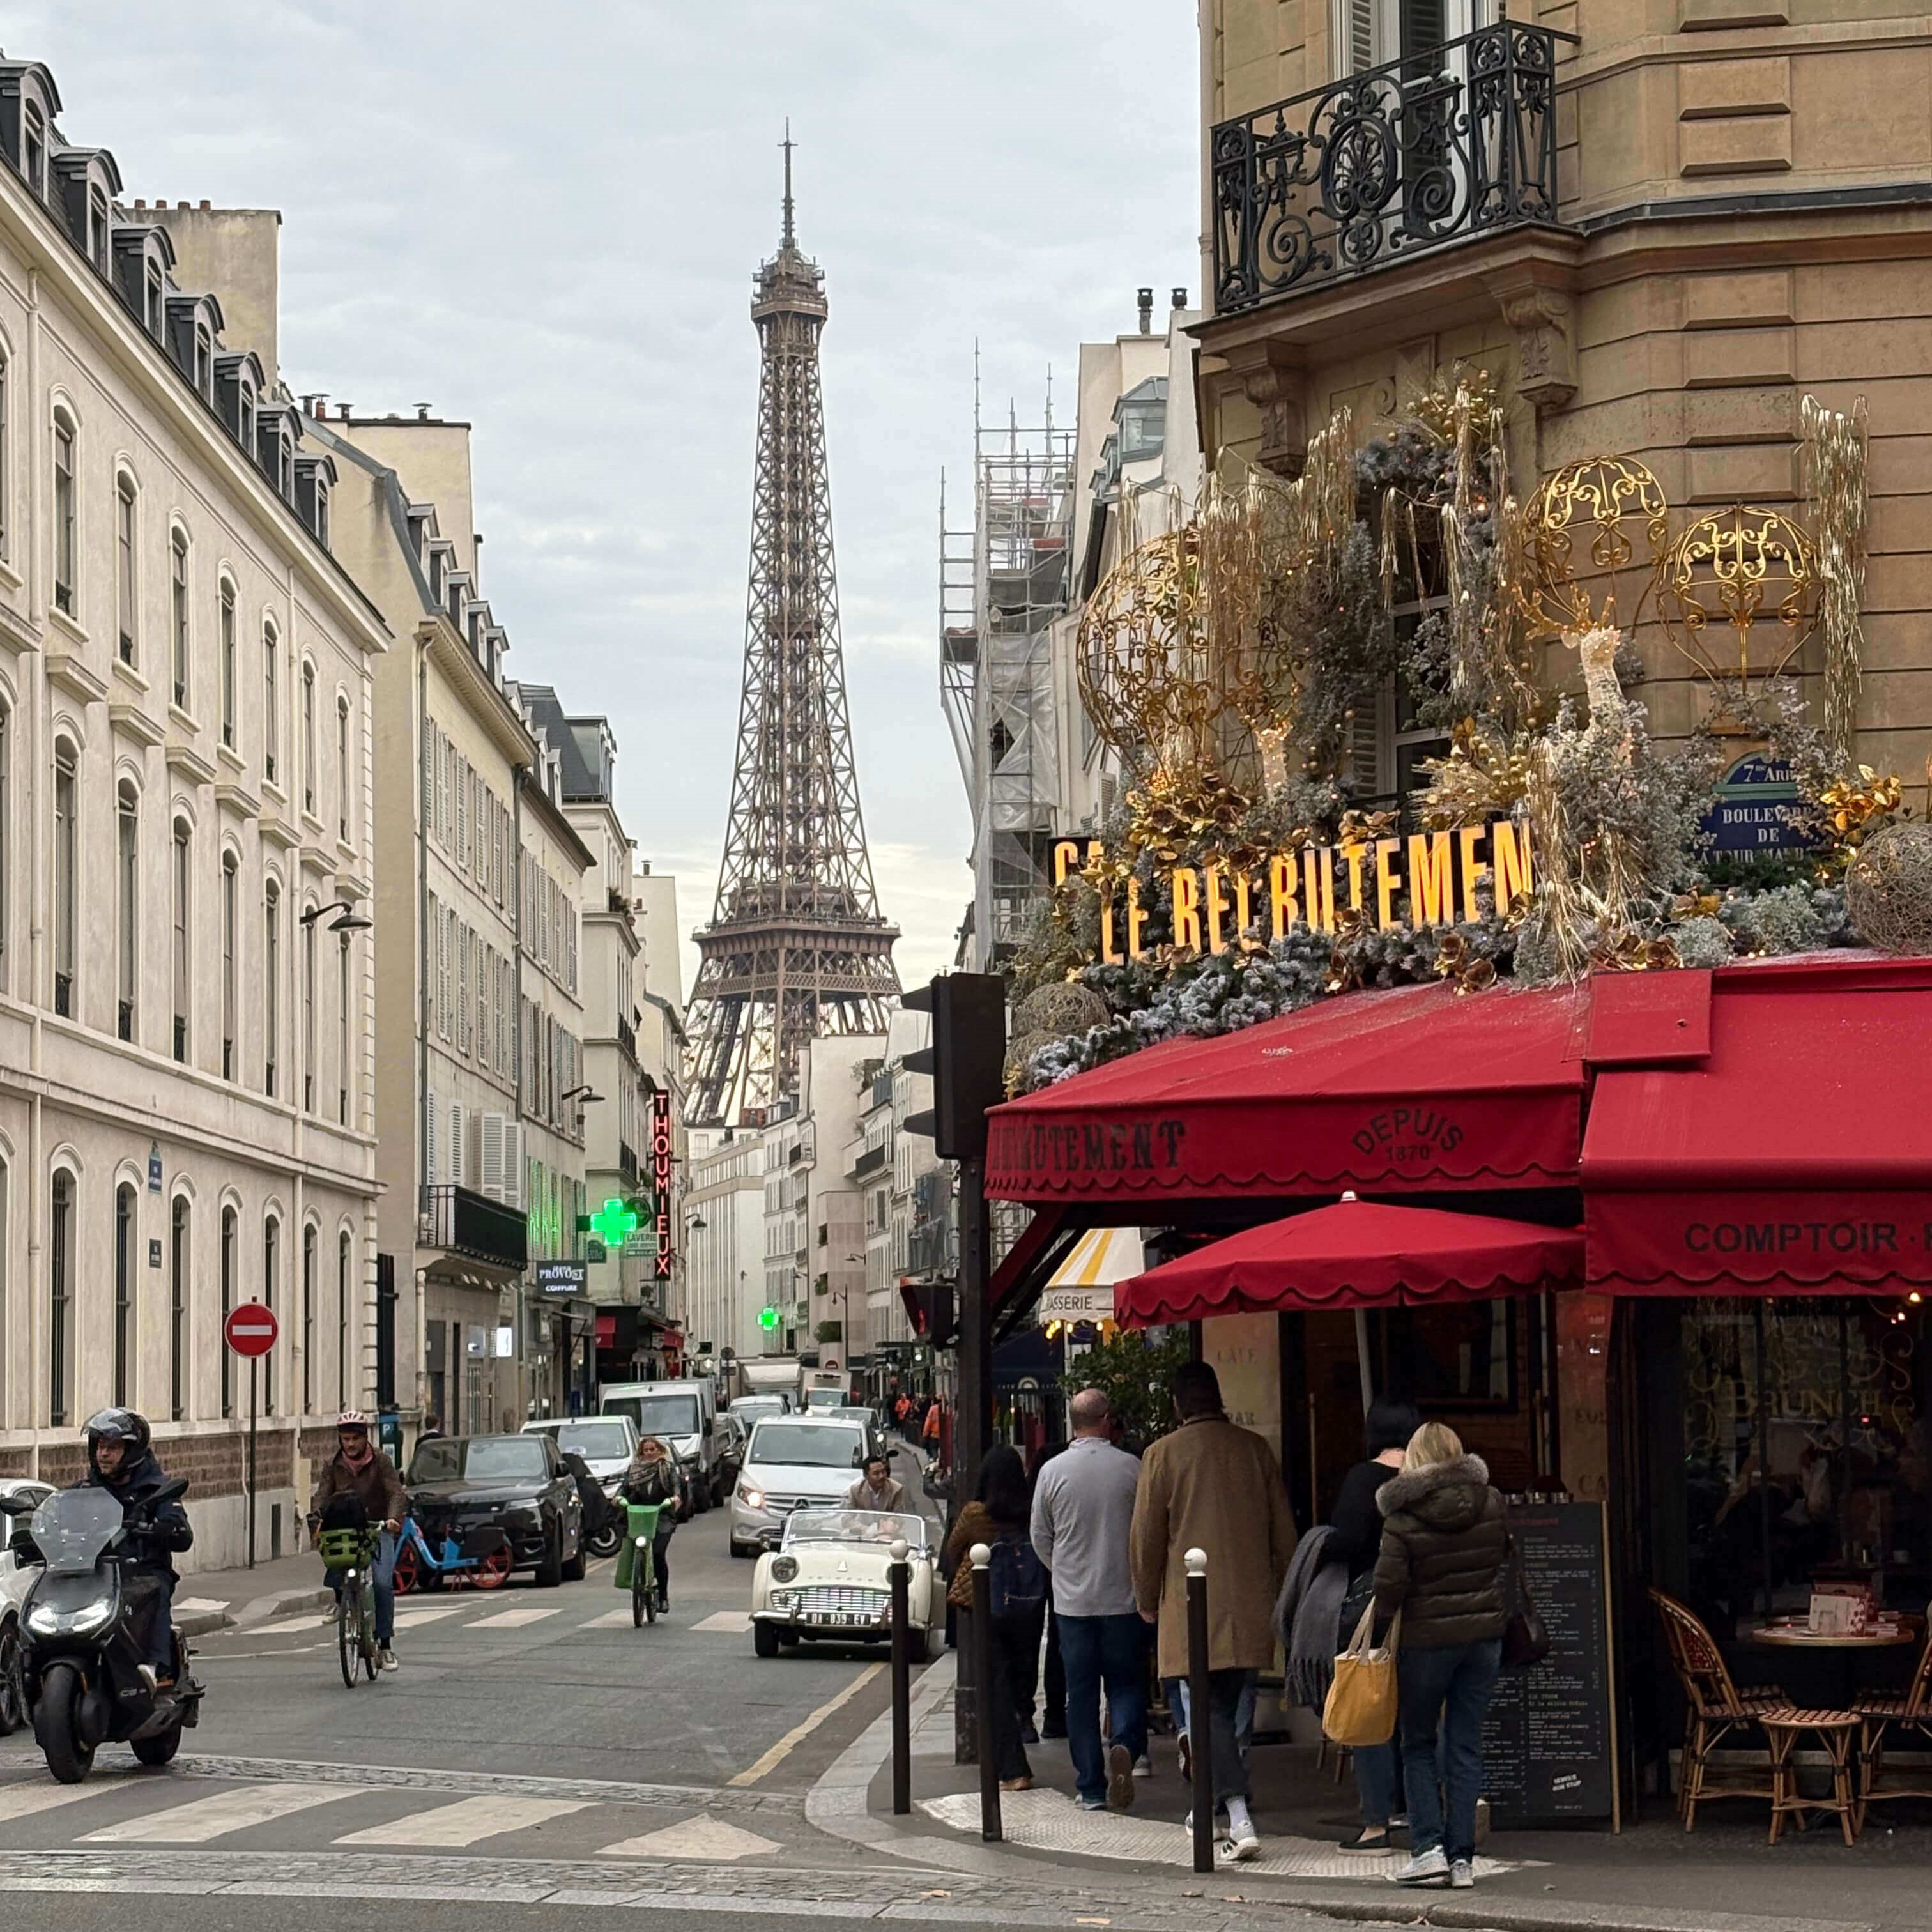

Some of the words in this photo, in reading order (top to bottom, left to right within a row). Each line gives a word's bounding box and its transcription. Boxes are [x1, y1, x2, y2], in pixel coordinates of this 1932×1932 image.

[1758, 828, 1779, 843] DE
[1712, 848, 1754, 863] TUR
[1101, 876, 1150, 967] LE
[1173, 818, 1533, 956] RECRUTEMEN
[1352, 1108, 1464, 1155] DEPUIS
[1386, 1145, 1430, 1162] 1870
[656, 1094, 669, 1275] THOUMIEUX
[1684, 1222, 1899, 1253] COMPTOIR
